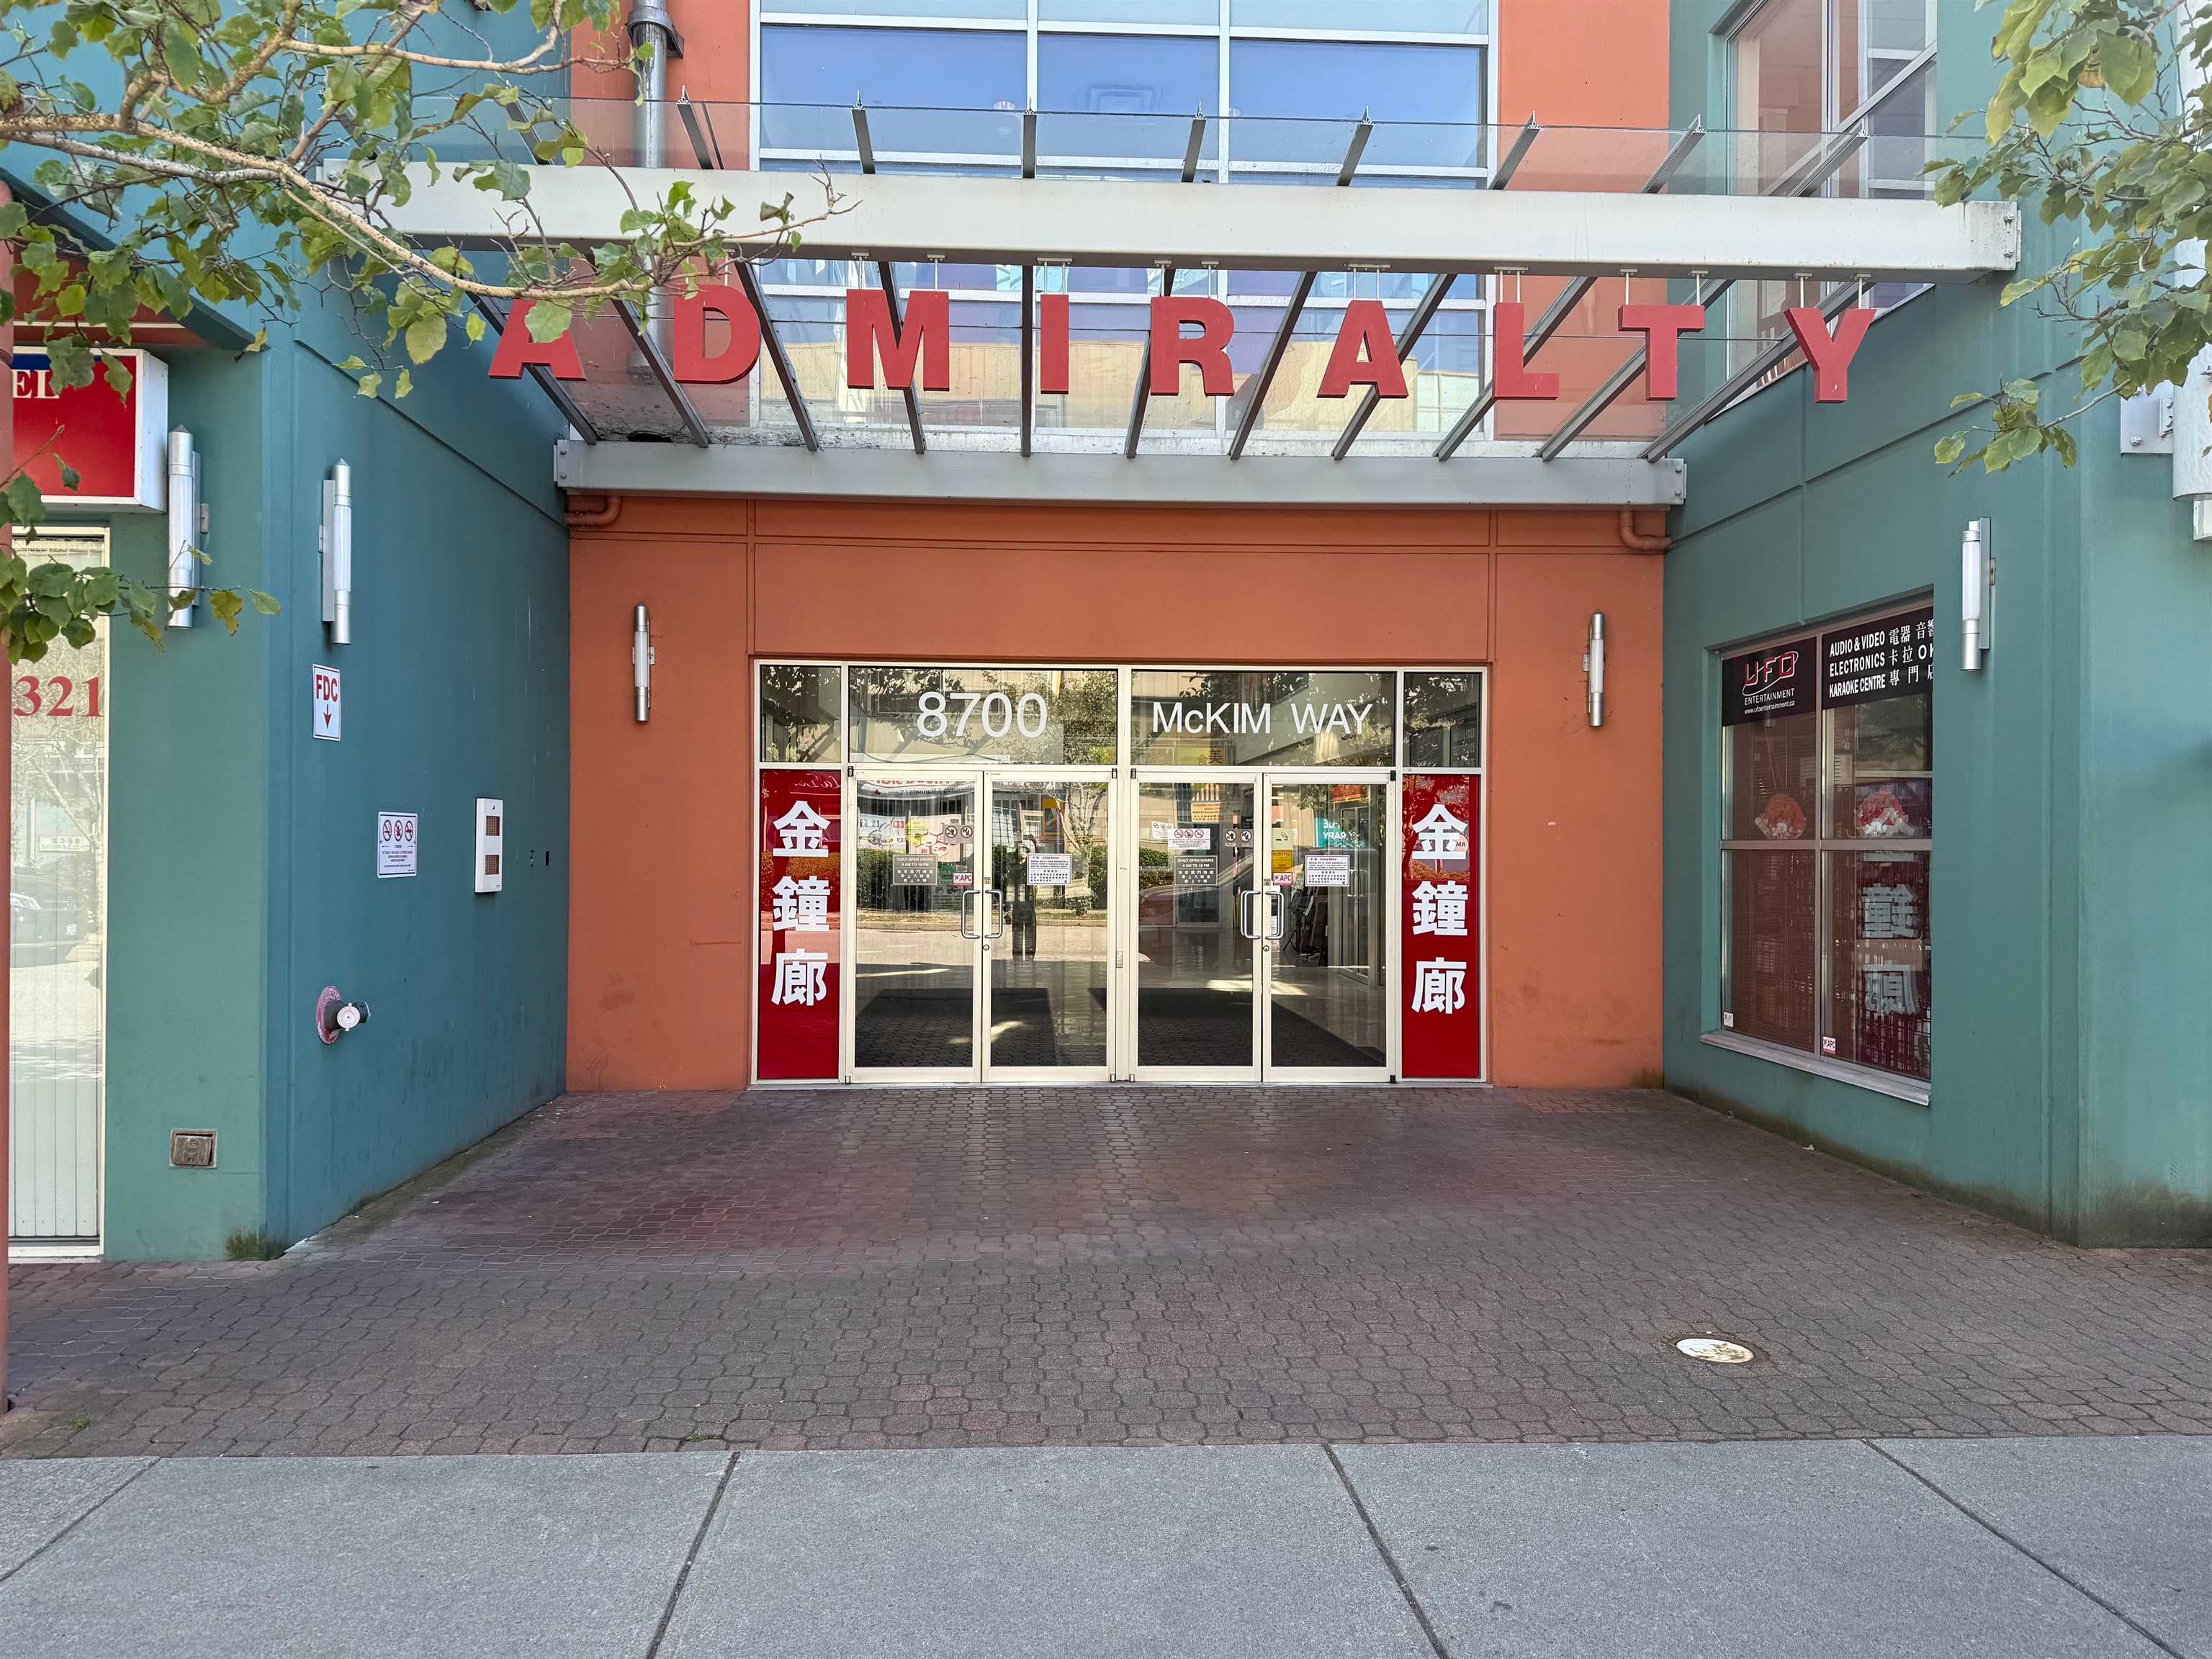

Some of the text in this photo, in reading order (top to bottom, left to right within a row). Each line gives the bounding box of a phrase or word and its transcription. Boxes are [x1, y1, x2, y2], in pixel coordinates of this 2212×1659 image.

[487, 284, 1876, 404] ADMIRALTY
[1830, 631, 1885, 657] AUDIO & VIDEO
[1889, 625, 1910, 645] 電器
[1745, 652, 1796, 686] UFO
[1830, 652, 1885, 677] ELECTRONICS
[13, 675, 104, 717] 321
[316, 674, 338, 702] FDC
[1744, 688, 1795, 706] ENTERTAINMENT
[1830, 674, 1886, 698] KARAOKE CENTRE
[917, 692, 1048, 738] 8700
[1153, 702, 1373, 734] McKIM WAY
[1744, 701, 1795, 714] www.ufoentertainment.ca
[771, 801, 831, 1006] 金鐘廊
[1412, 804, 1468, 1014] 金鐘廊
